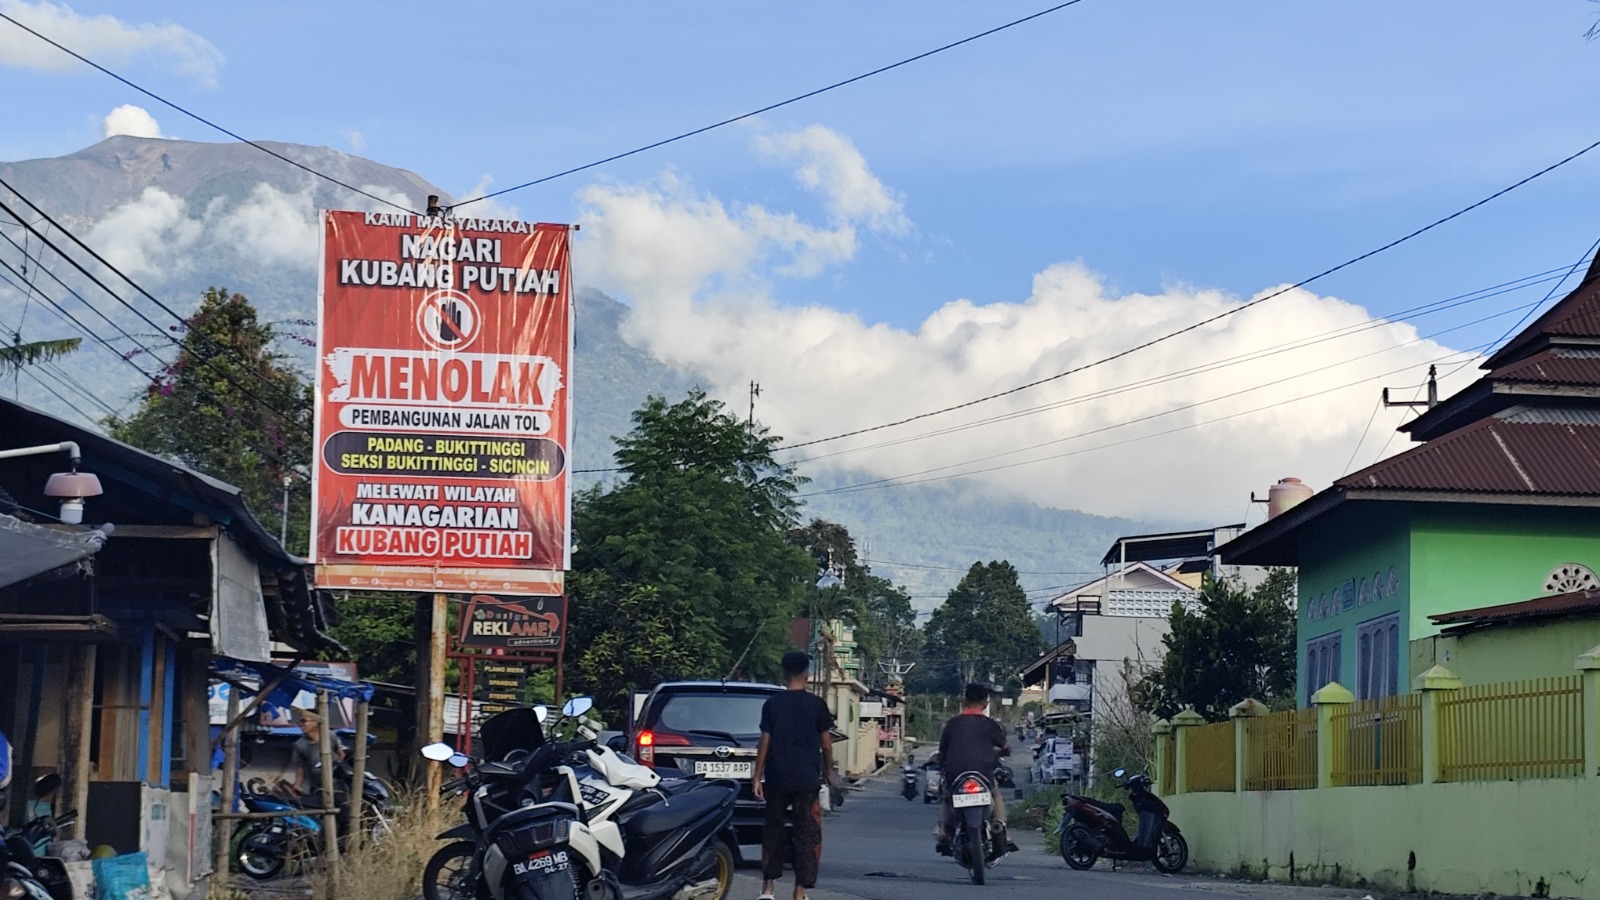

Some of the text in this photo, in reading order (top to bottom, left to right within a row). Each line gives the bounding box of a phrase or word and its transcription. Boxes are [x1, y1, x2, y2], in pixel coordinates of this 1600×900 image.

[363, 211, 537, 234] KAMI MASYARAKAT
[402, 234, 502, 263] NAGARI
[341, 259, 560, 294] KUBANG PUTIAH
[350, 355, 545, 405] MENOLAK
[352, 409, 540, 432] PEMBANGUNAN JALAN TOL
[367, 437, 424, 453] PADANG
[435, 440, 526, 457] BUKITTINGGI
[341, 453, 383, 469] SEKSI
[387, 455, 478, 472] BUKITTINGGI
[489, 459, 550, 475] SICINCIN
[356, 483, 516, 503] MELEWATI WILAYAH
[352, 503, 519, 529] KANAGARIAN
[338, 528, 532, 558] KUBANG PUTIAH
[472, 621, 549, 637] REKLAME
[696, 763, 749, 773] BA 1537 AAP
[513, 851, 569, 875] BA 4269 MB
